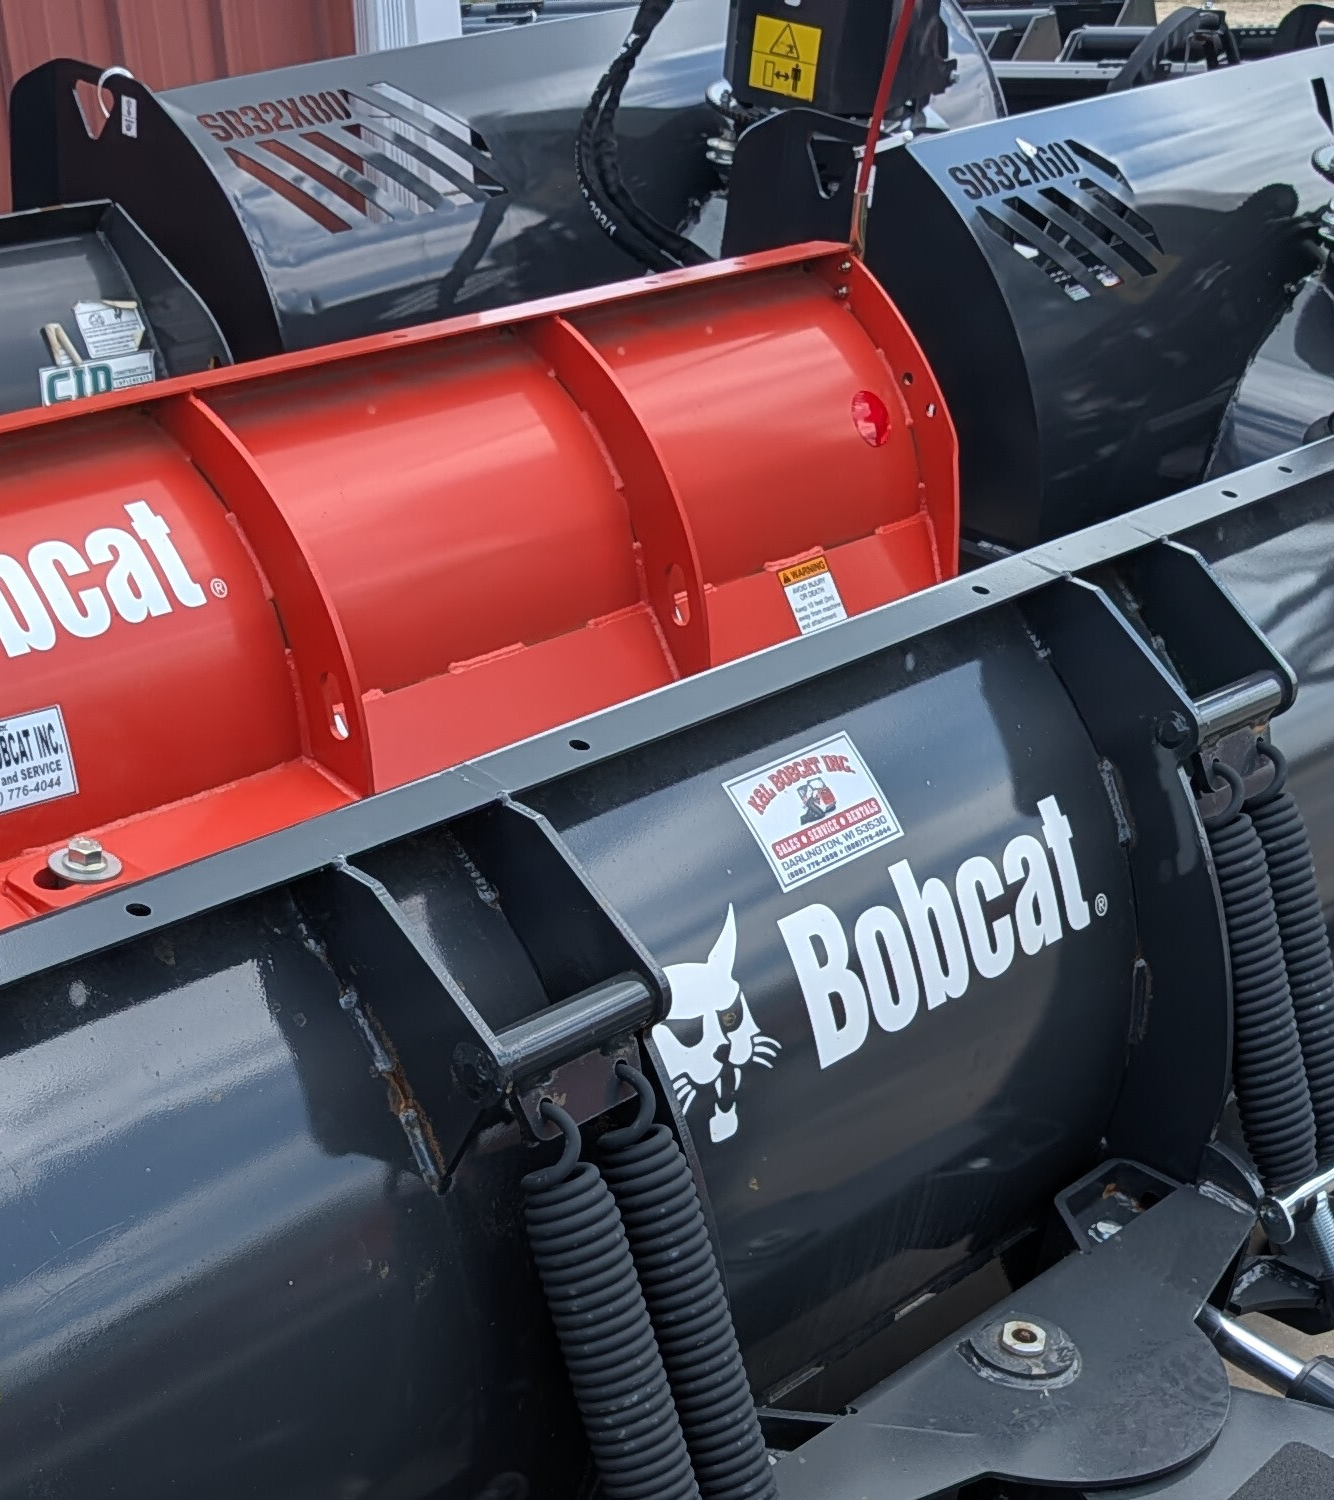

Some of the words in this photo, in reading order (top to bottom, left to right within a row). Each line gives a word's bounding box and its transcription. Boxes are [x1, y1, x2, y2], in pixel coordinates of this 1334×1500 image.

[789, 560, 826, 579] WARNING
[33, 722, 64, 759] INC.
[1, 770, 19, 787] and
[20, 759, 63, 781] SERVICE
[7, 775, 62, 801] 776-4044
[747, 783, 778, 816] K&L
[767, 756, 823, 793] BOBCAT
[774, 836, 802, 857] SALES
[806, 819, 841, 842] SERVICE
[845, 800, 879, 824] RENTALS
[841, 829, 856, 843] WI
[855, 814, 888, 836] 53530
[776, 794, 1092, 1070] Bobcat
